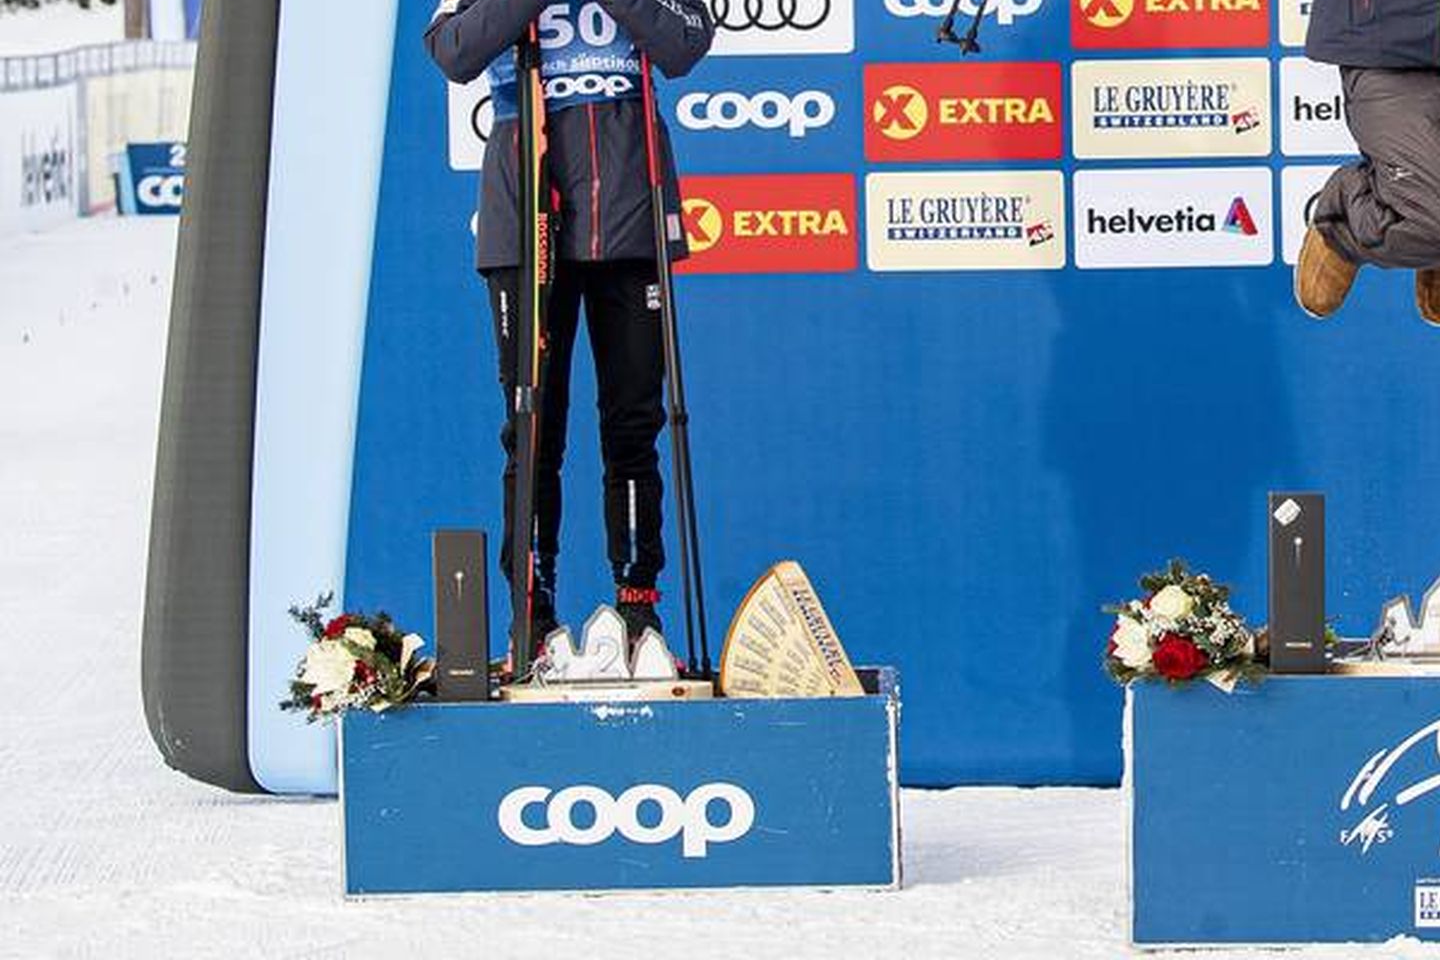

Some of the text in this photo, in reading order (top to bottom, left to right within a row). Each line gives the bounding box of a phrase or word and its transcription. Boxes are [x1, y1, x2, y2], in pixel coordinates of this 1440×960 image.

[537, 1, 617, 49] 50
[939, 96, 1055, 124] EXTRA
[1094, 80, 1230, 113] LE GRUYÈRE
[675, 90, 837, 137] coop
[733, 209, 848, 238] EXTRA
[887, 192, 1024, 226] LE GRUYÈRE
[1087, 206, 1216, 235] helvetia
[498, 782, 756, 858] coop
[1419, 891, 1437, 909] LE
